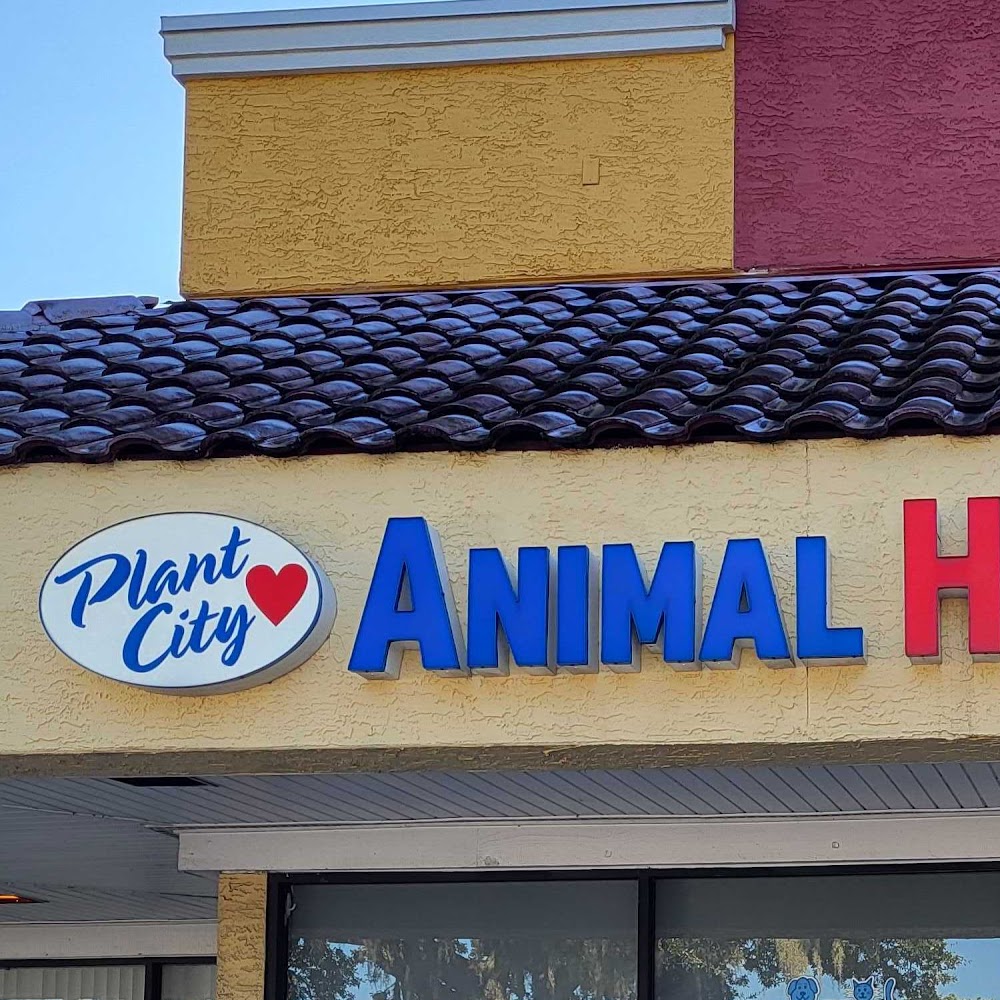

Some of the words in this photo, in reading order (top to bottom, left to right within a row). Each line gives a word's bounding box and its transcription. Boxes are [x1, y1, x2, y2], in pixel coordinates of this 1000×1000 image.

[54, 526, 252, 628] Plant
[348, 516, 866, 678] ANIMAL
[122, 599, 255, 675] City
